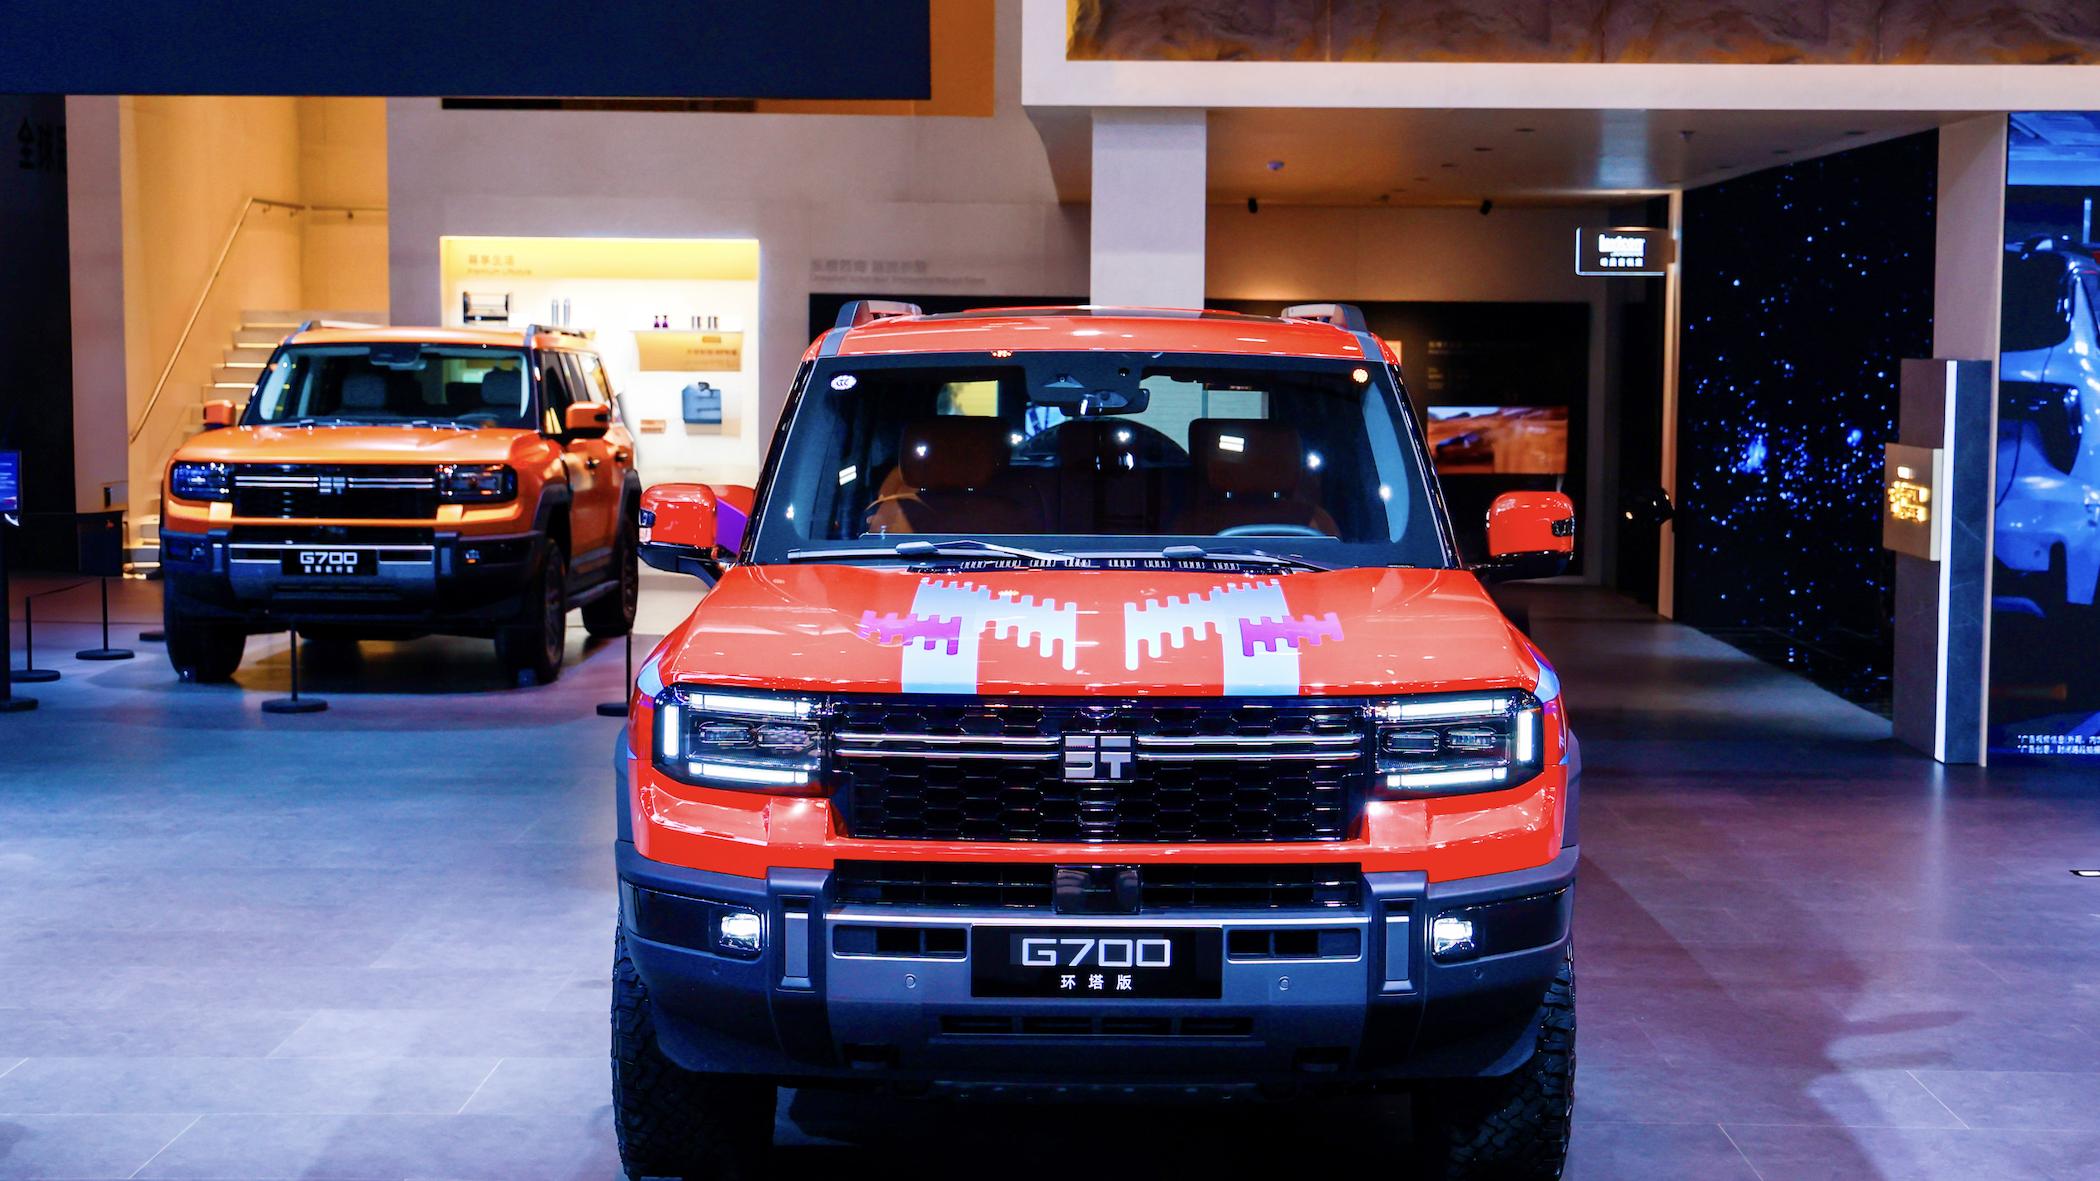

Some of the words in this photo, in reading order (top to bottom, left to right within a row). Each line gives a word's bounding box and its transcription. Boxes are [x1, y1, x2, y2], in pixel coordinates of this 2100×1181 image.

[300, 551, 358, 564] G700
[1022, 938, 1171, 967] G700
[1060, 974, 1132, 990] 环塔版
